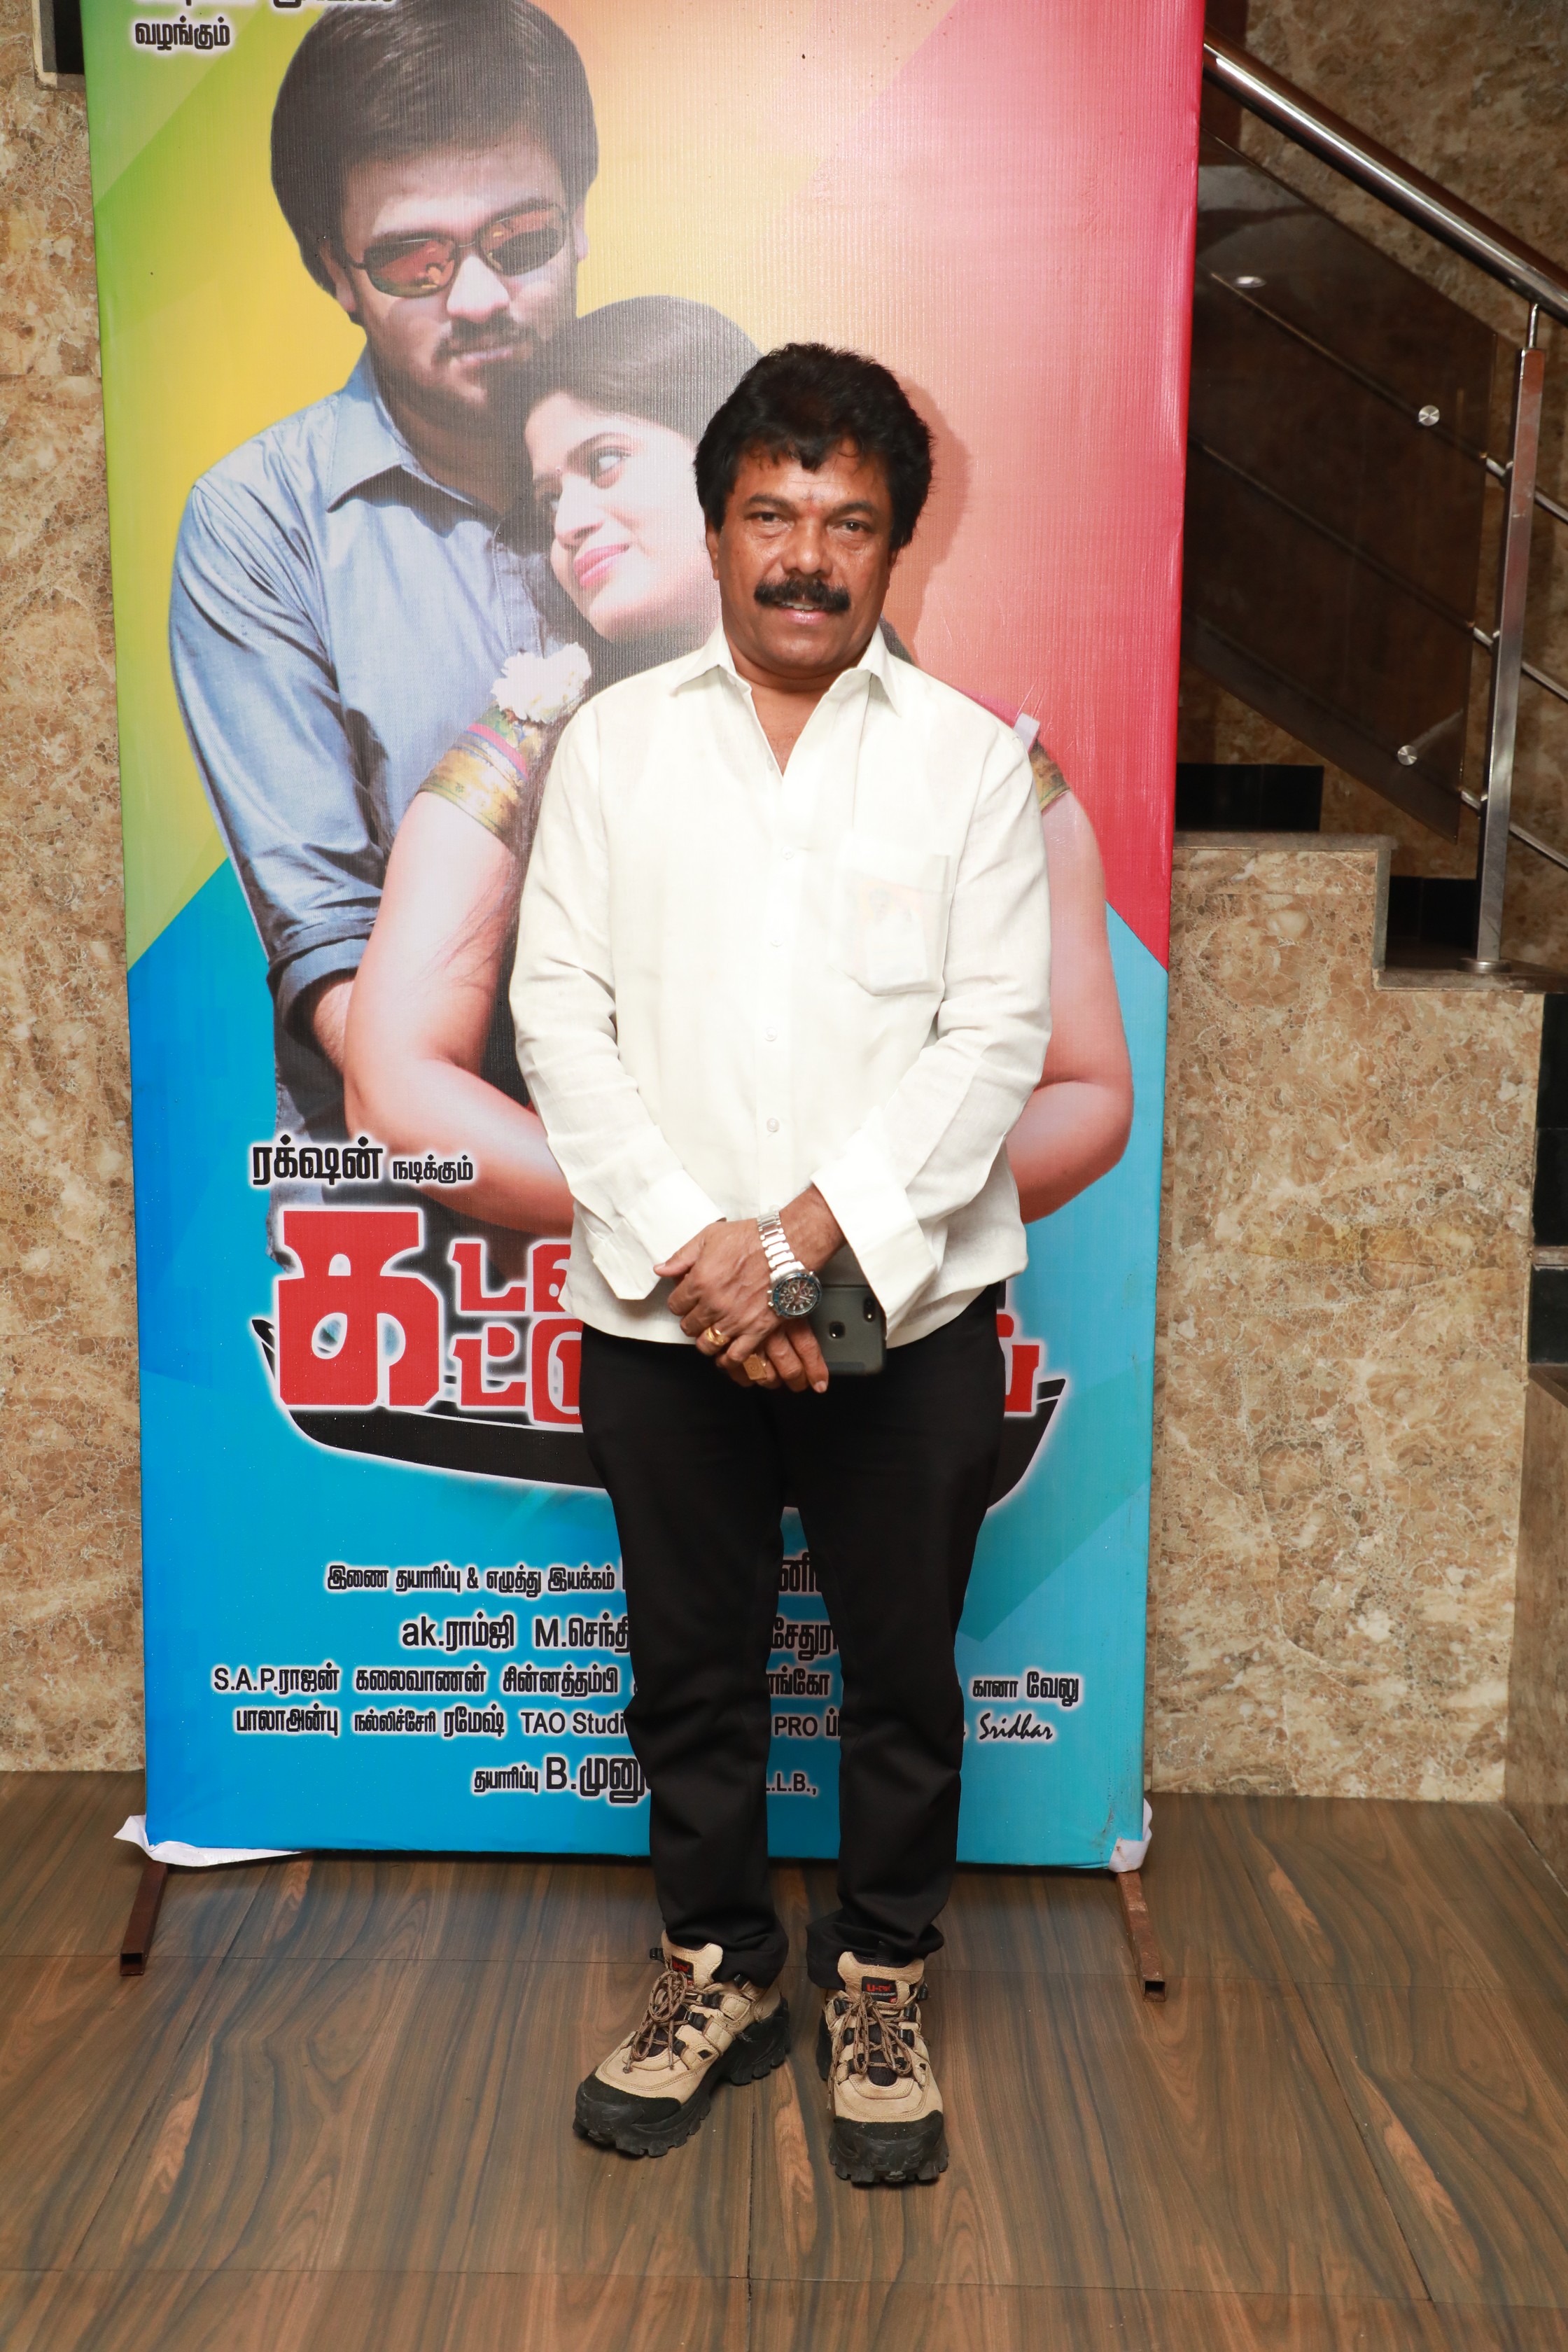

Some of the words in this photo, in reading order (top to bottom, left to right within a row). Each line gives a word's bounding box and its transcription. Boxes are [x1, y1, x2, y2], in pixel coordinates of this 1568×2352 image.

[135, 15, 230, 50] வழங்கும்
[393, 1154, 473, 1183] நடிக்கும்
[328, 1565, 388, 1590] இணை
[396, 1564, 461, 1592] தயாரிப்பு
[467, 1567, 479, 1589] &
[486, 1564, 542, 1597] எழுத்து
[547, 1564, 615, 1591] இயக்கம்
[402, 1611, 514, 1651] ak.ராம்ஜி
[536, 1612, 629, 1653] M.செந்தி
[214, 1662, 340, 1695] S.A.P.ராஜன்
[356, 1663, 486, 1692] கலைவாணன்
[503, 1663, 618, 1697] சின்னத்தம்பி
[972, 1680, 1018, 1698] கானா
[1026, 1671, 1079, 1707] வேலு
[354, 1708, 436, 1732] நல்லிச்சேரி
[444, 1703, 505, 1737] ரமேஷ்
[520, 1712, 566, 1734] TAO
[573, 1712, 626, 1734] Studi
[774, 1716, 818, 1737] PRO
[979, 1712, 1053, 1740] Sridhar
[474, 1764, 538, 1793] தயாரிப்பு
[546, 1756, 650, 1803] B.முனு
[766, 1772, 816, 1795] .L.B.,
